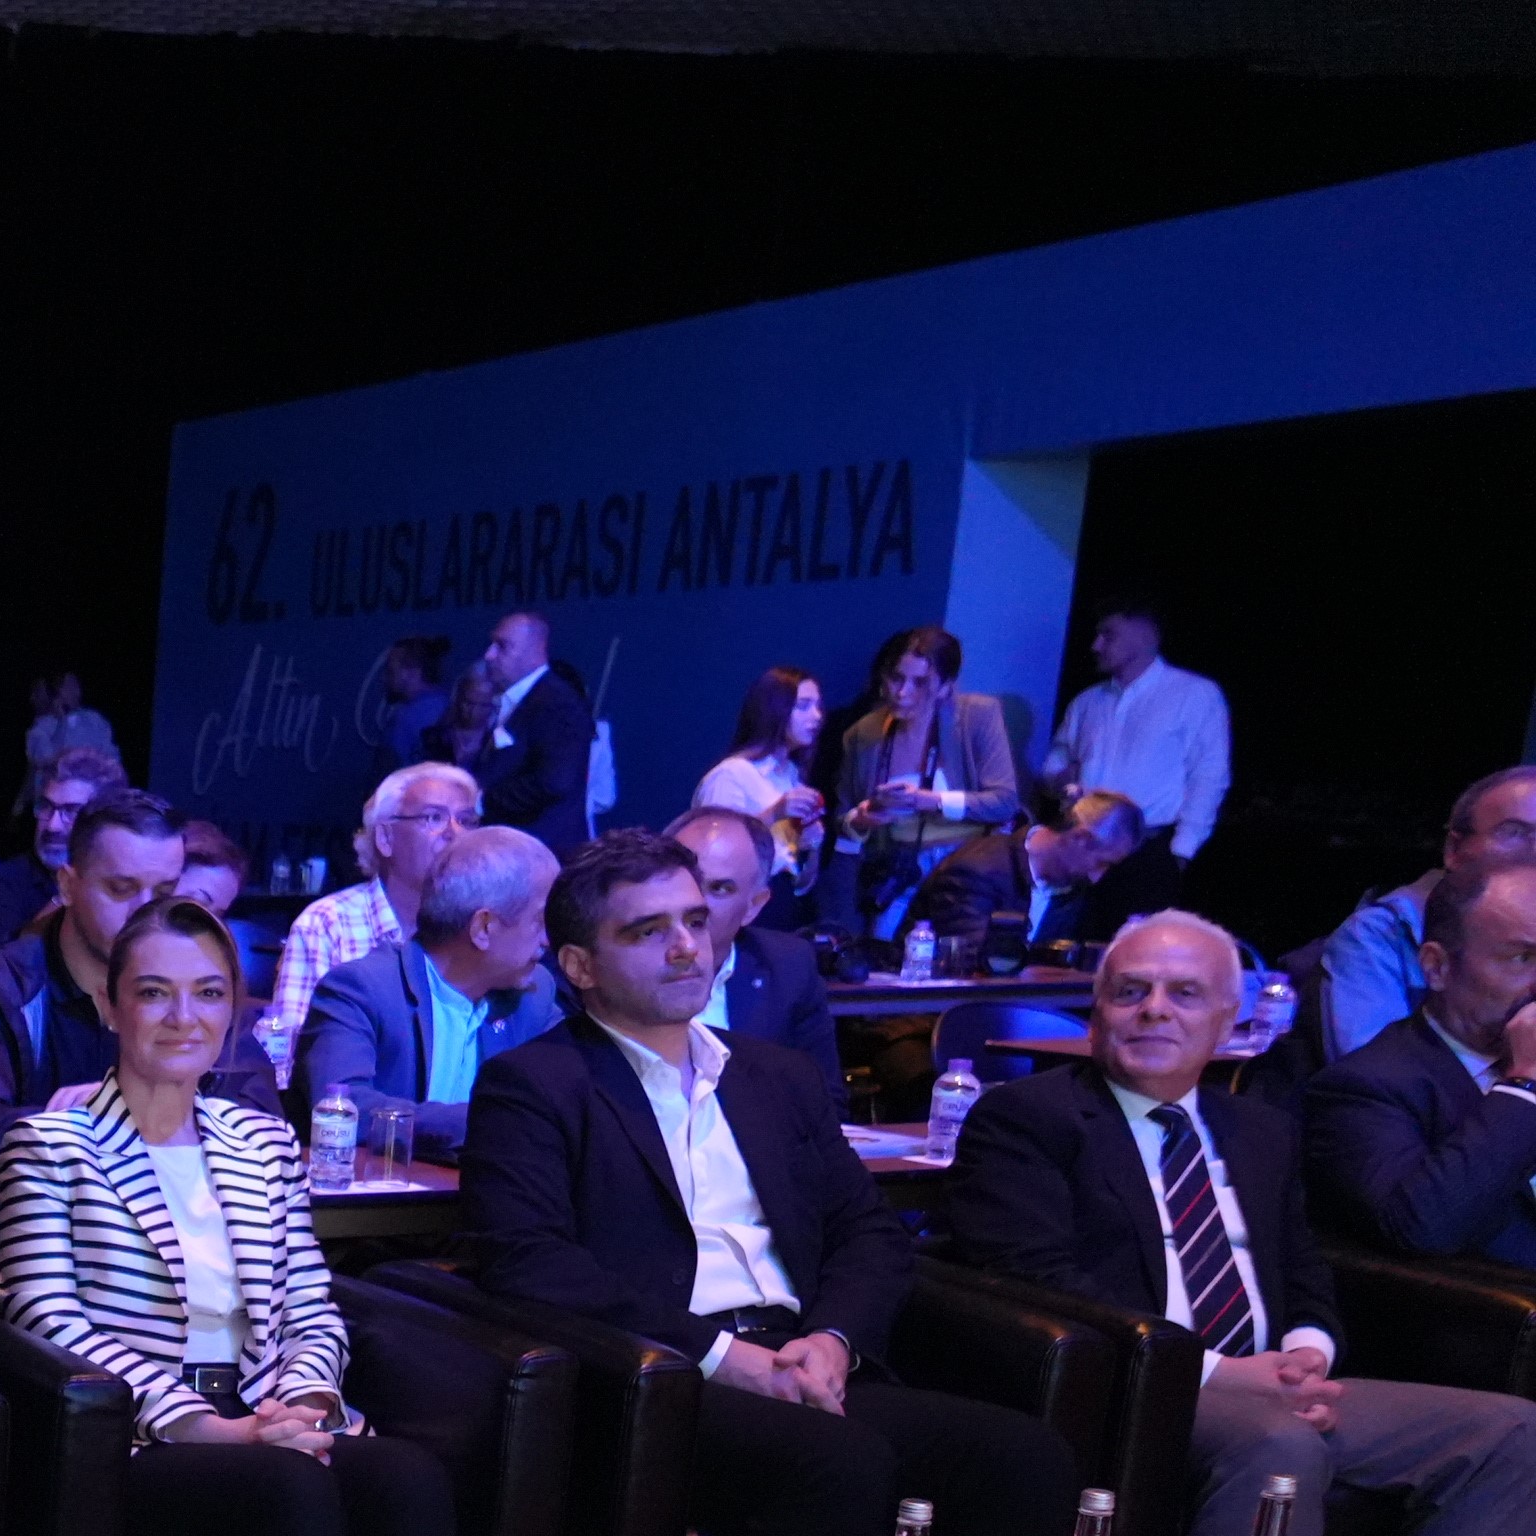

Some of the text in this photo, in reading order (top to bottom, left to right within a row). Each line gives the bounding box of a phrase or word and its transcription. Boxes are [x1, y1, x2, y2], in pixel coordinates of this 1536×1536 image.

[205, 458, 916, 626] 62. ULUSLARARASI ANTALYA
